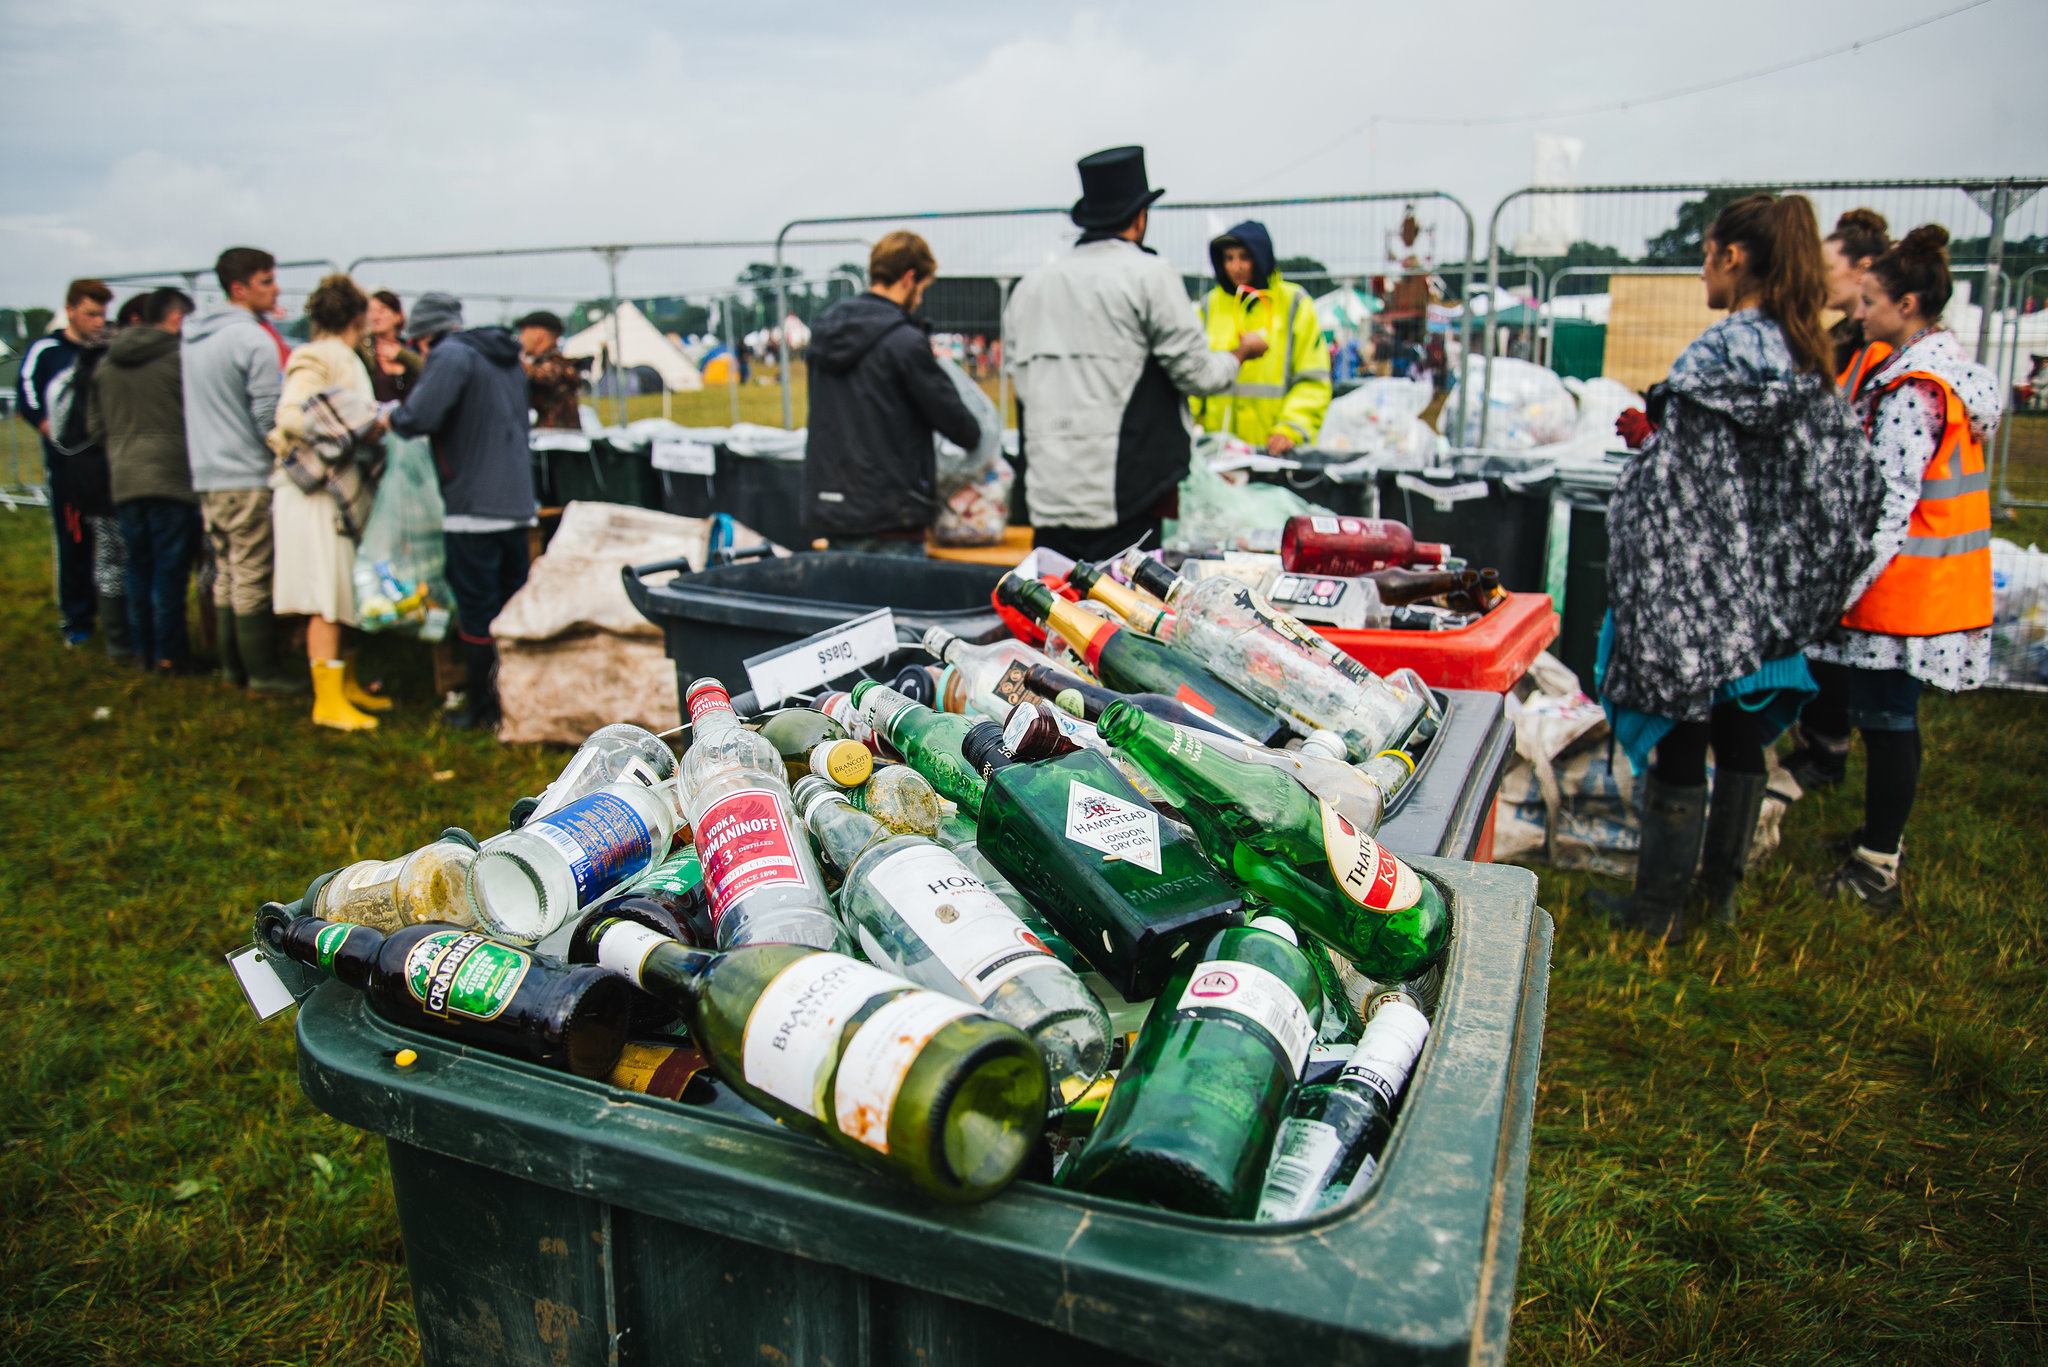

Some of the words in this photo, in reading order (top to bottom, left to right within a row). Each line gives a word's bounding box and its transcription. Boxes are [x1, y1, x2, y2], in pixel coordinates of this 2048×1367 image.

[818, 641, 852, 664] Glass
[834, 754, 869, 774] BRANCOTT
[706, 815, 736, 840] VODKA
[1073, 810, 1147, 834] HAMPSTEAD
[738, 840, 774, 854] DISTILLED
[1101, 827, 1146, 844] LONDON
[1110, 841, 1132, 852] DRY
[1132, 836, 1152, 846] GIN
[734, 874, 759, 890] SINCE
[760, 869, 778, 879] 1890
[458, 950, 488, 998] Alcoholic
[465, 956, 494, 995] GINGER
[476, 963, 498, 991] BEER
[773, 963, 858, 1051] BRANCOTT
